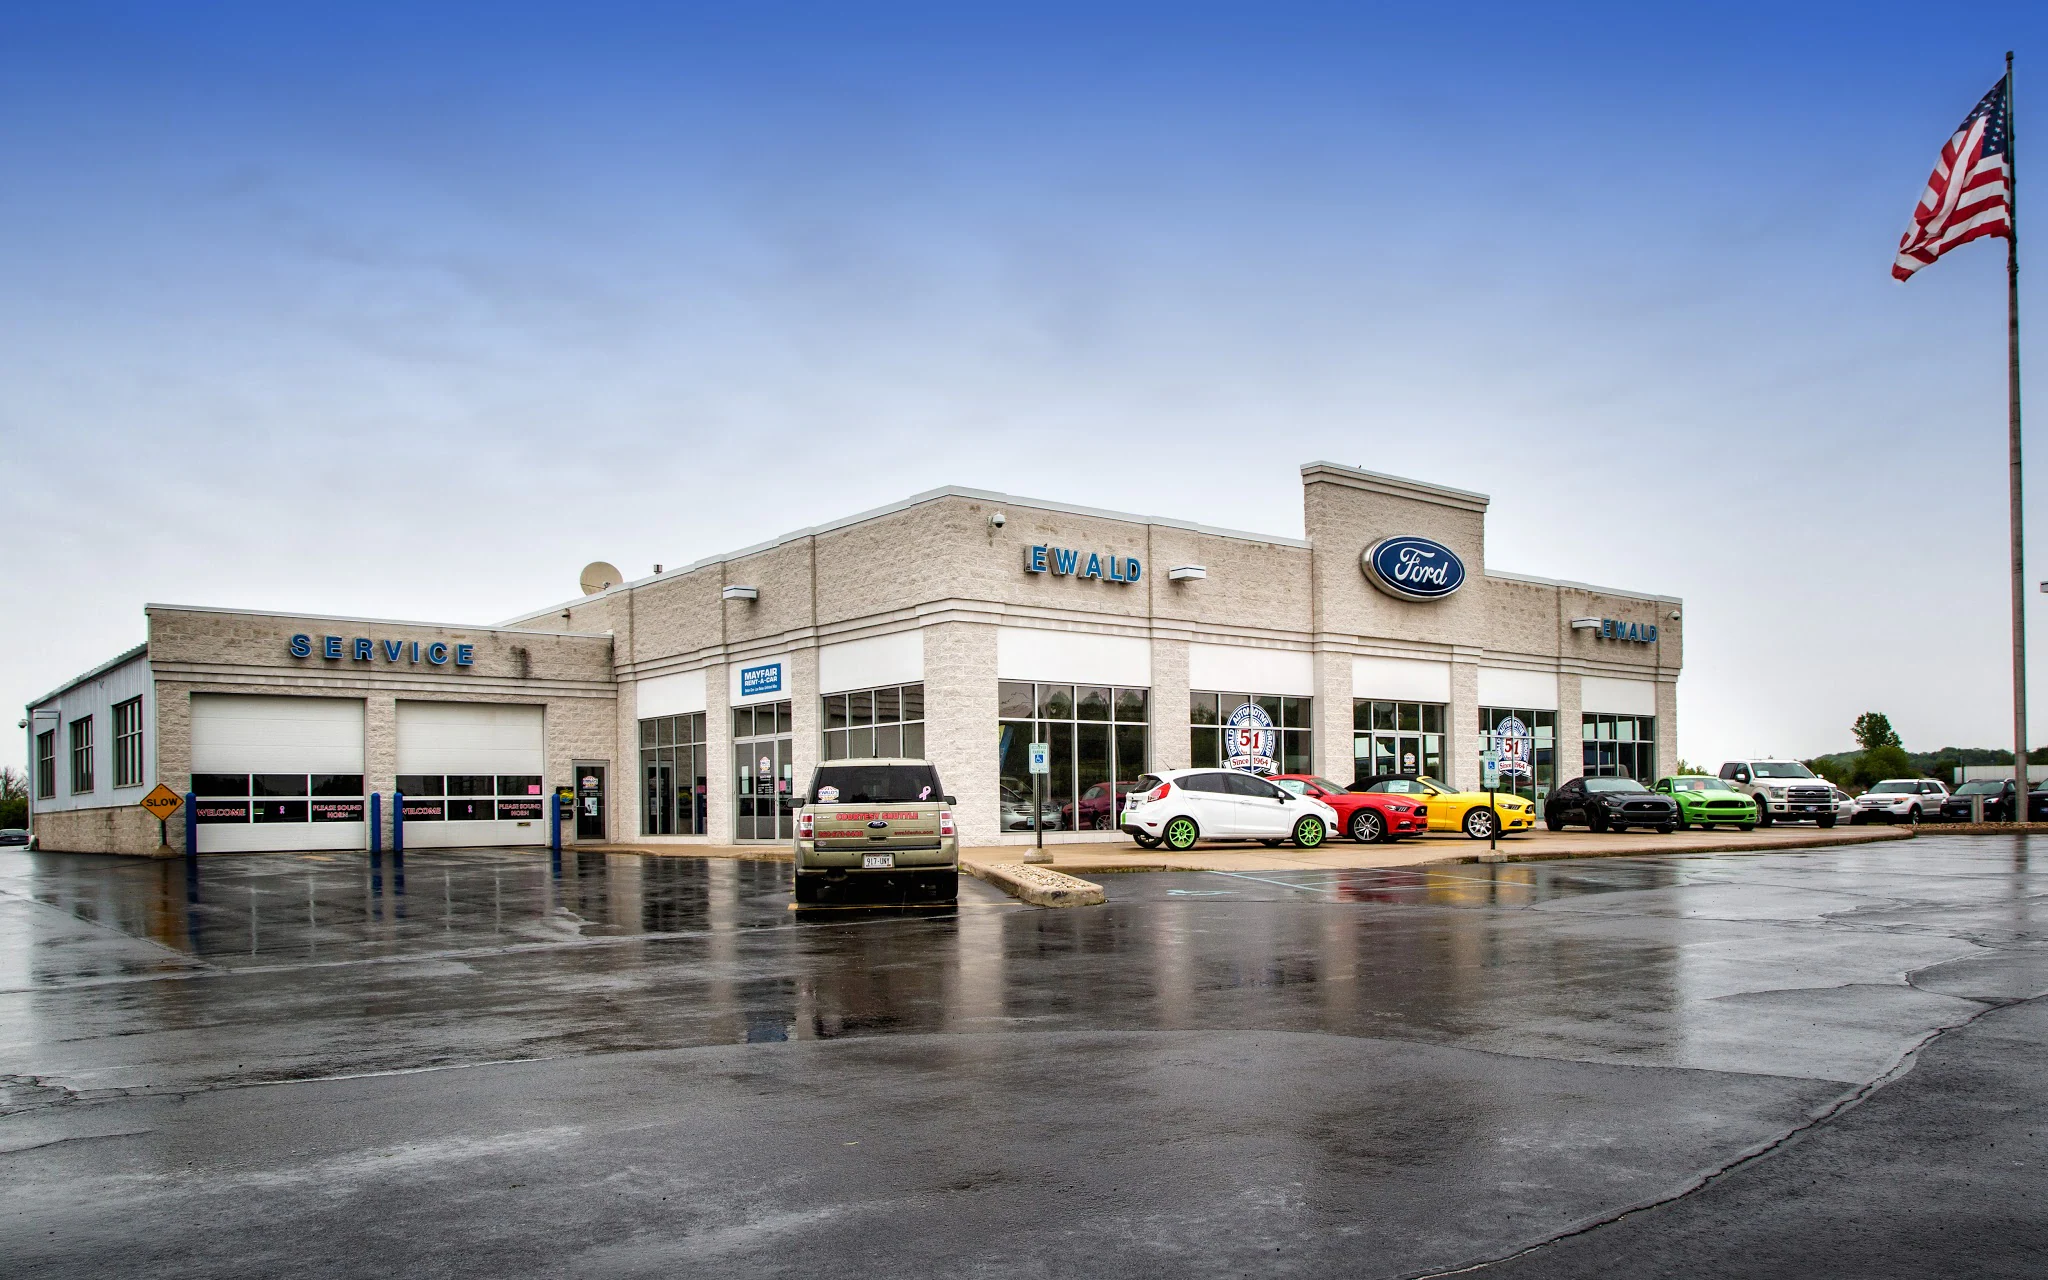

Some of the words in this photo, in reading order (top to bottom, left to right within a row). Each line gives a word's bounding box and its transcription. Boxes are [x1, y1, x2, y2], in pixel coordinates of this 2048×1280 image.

[1029, 545, 1142, 583] EWALD
[1394, 547, 1449, 586] Ford
[1602, 618, 1657, 643] EWALD
[290, 633, 475, 666] SERVICE
[744, 667, 778, 681] MAYFAIR
[744, 676, 778, 687] RENT-A-CAR
[1232, 706, 1269, 726] AUTOMOTIVE
[1228, 728, 1238, 755] EWALD
[1239, 729, 1260, 749] 51
[1266, 729, 1274, 757] GROUP
[1504, 737, 1519, 755] 51
[1232, 758, 1249, 767] Since
[1253, 757, 1269, 767] 1964
[146, 798, 178, 807] SLOW
[519, 803, 541, 811] SOUND
[196, 808, 247, 817] WELCOME
[835, 812, 880, 821] COURTESY
[881, 811, 919, 820] SHUTTLE
